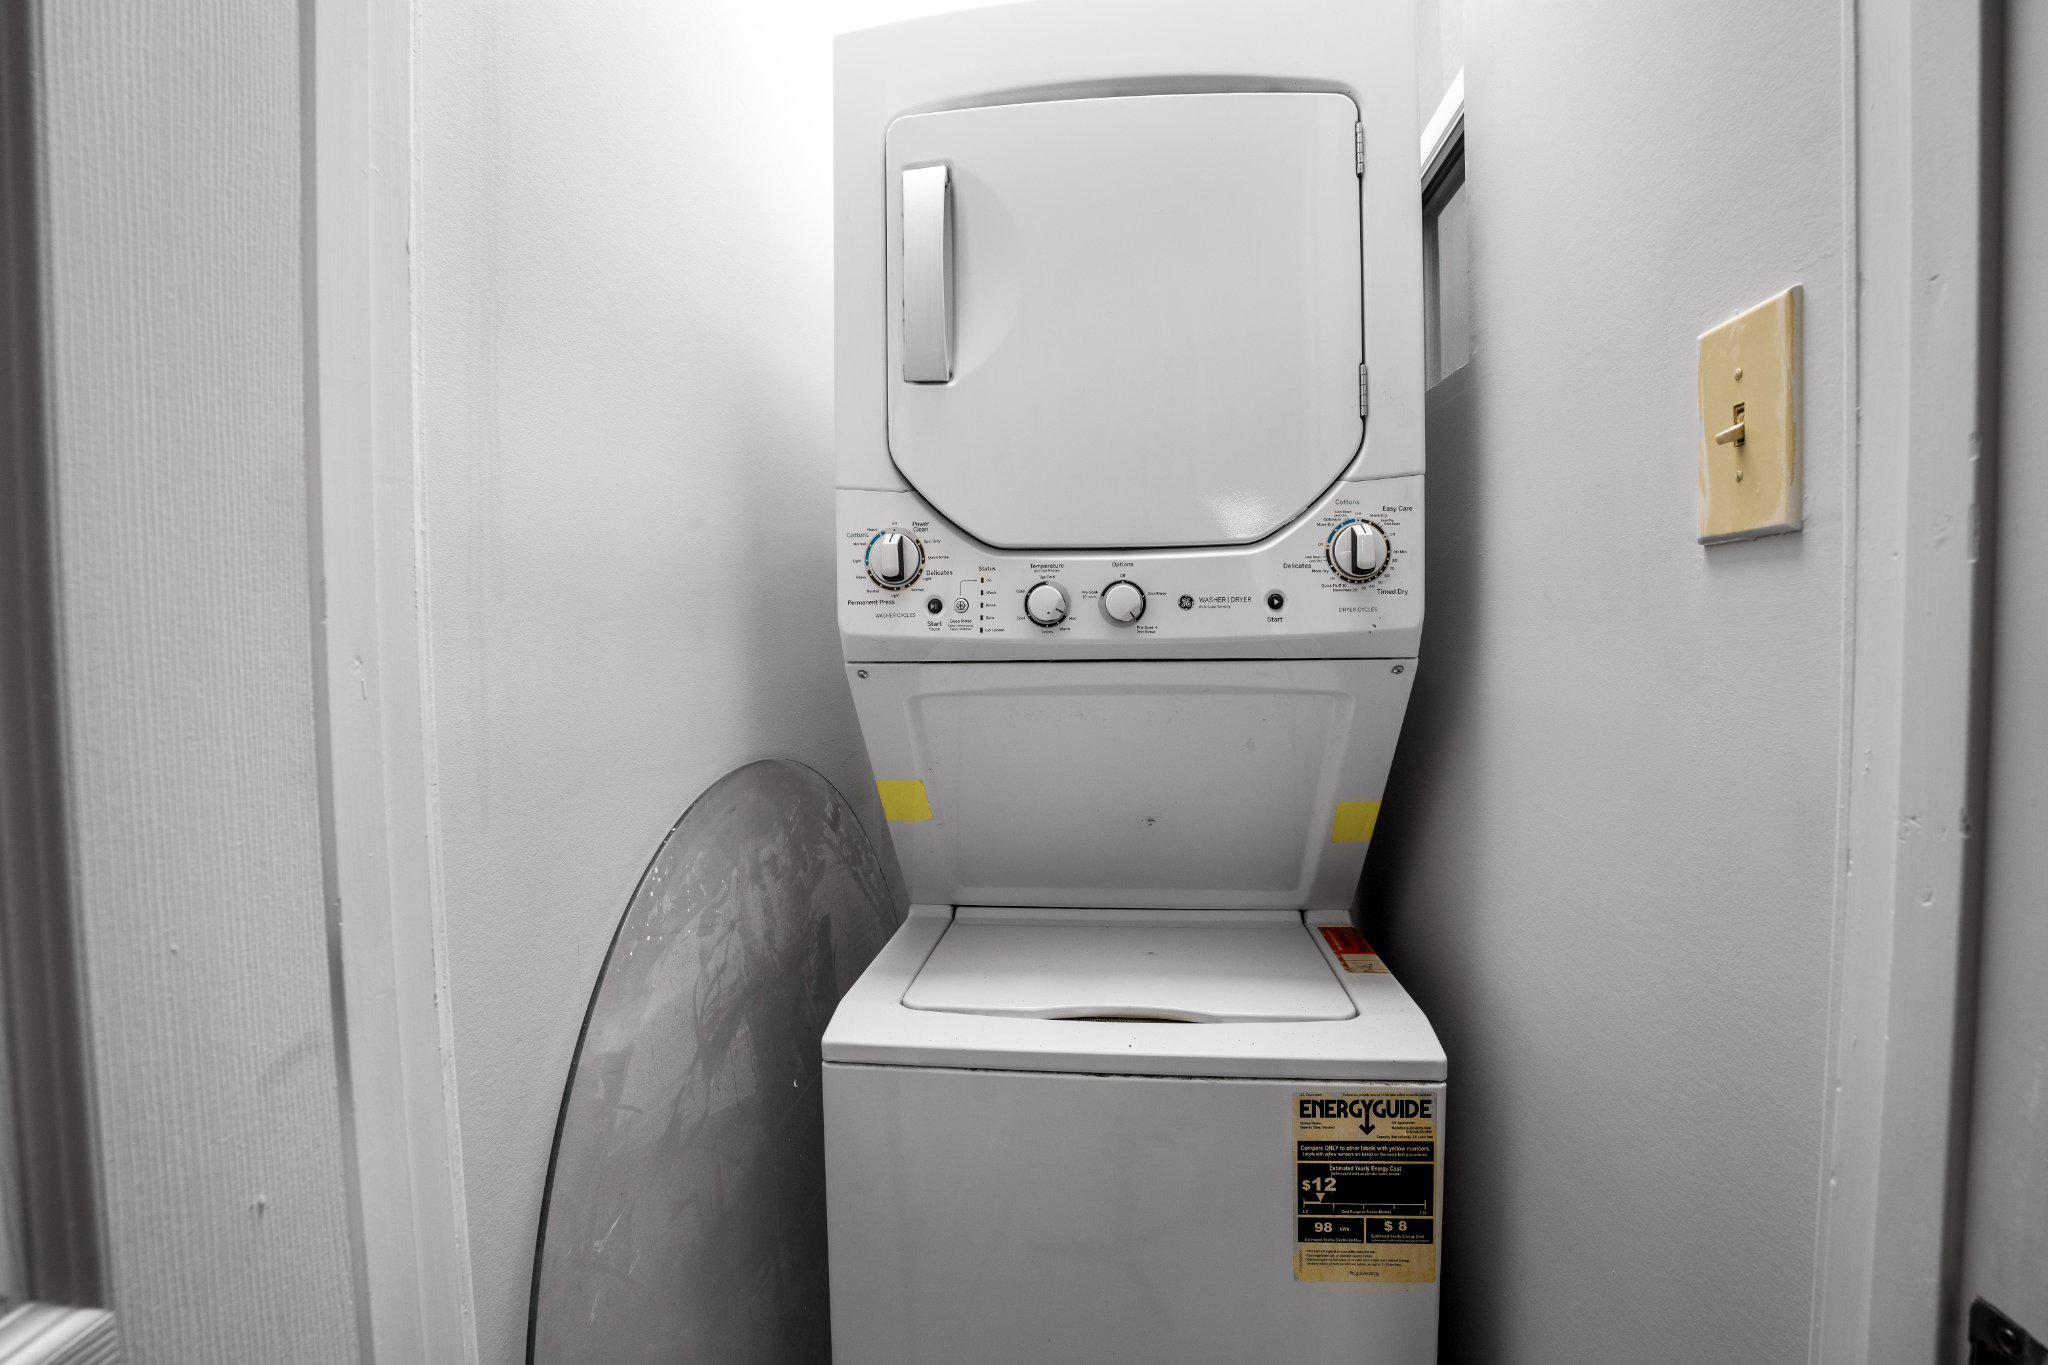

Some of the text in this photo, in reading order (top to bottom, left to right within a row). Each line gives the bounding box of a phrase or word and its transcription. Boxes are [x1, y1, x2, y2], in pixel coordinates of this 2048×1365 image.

[1299, 1099, 1432, 1119] ENERGYGUIDE
[1301, 1177, 1337, 1191] $12
[1314, 1222, 1332, 1232] 98
